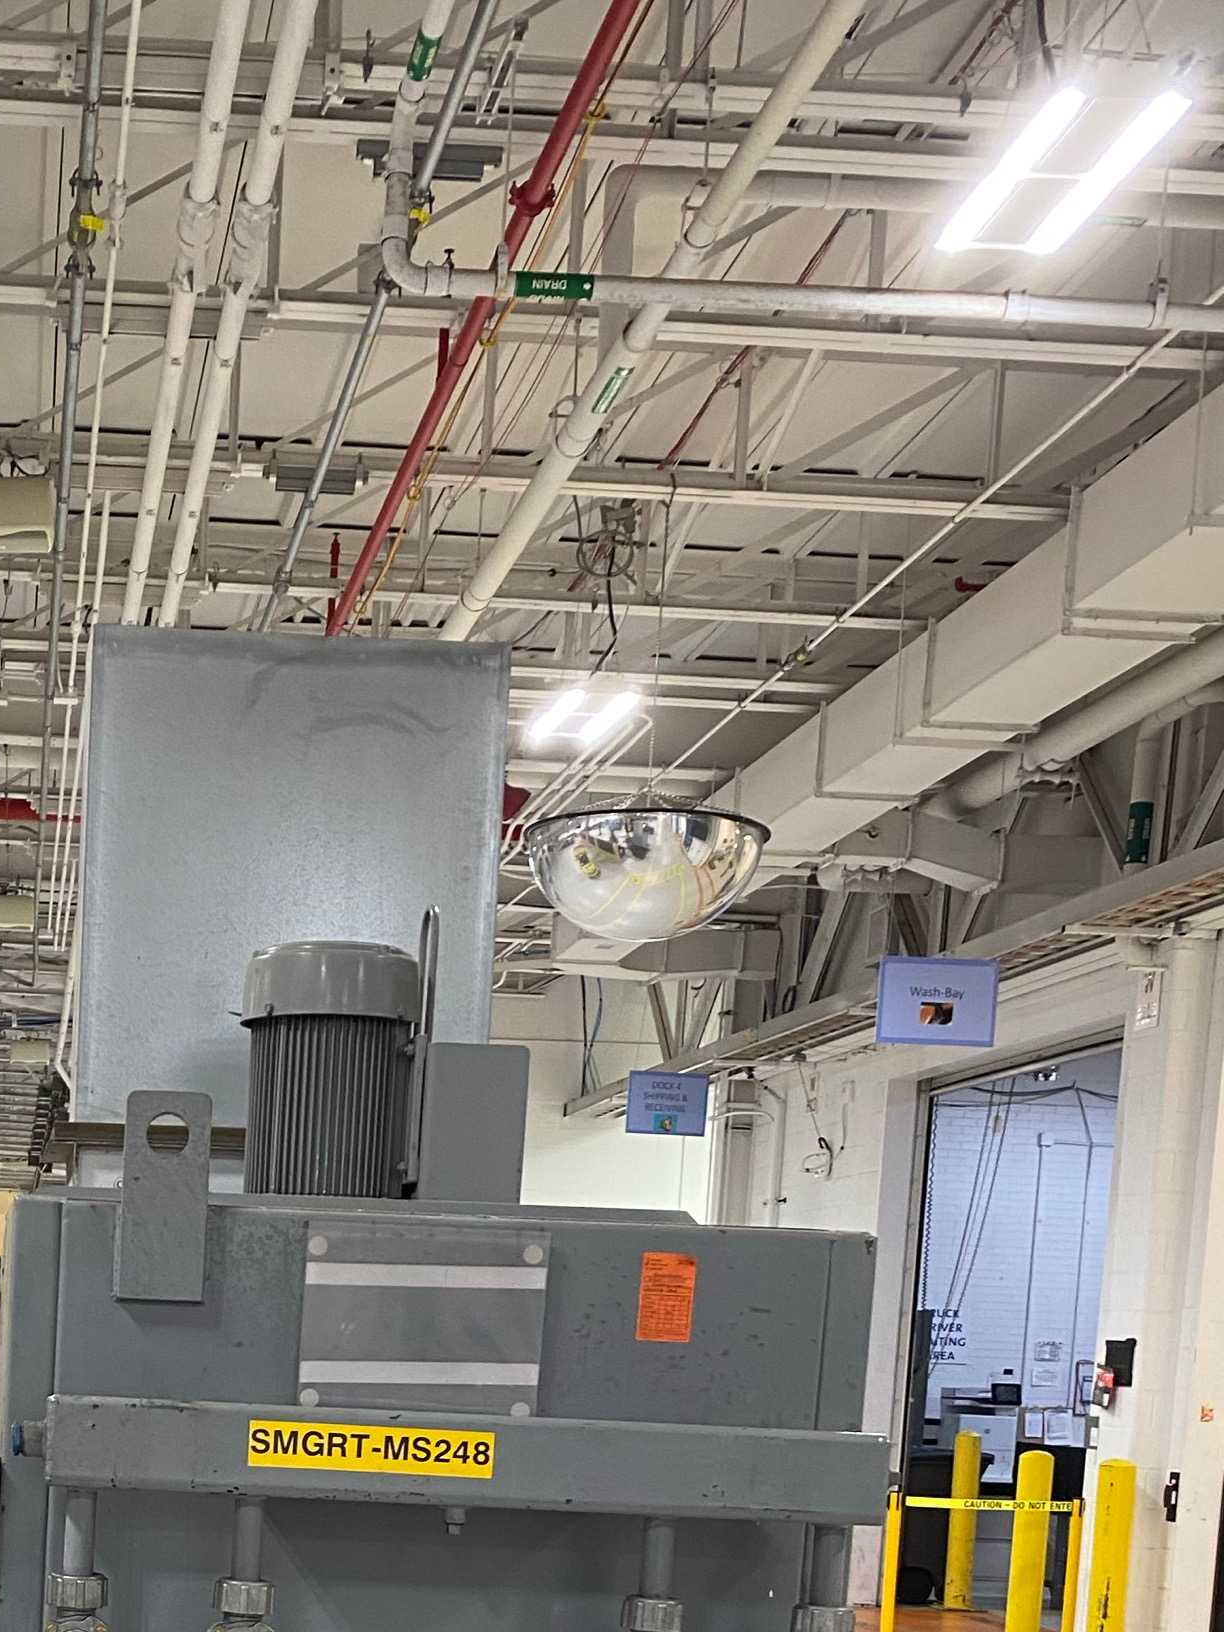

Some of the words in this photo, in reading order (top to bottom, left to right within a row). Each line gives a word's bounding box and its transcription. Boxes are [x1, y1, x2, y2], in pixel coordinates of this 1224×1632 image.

[532, 279, 567, 290] DRAIN
[909, 986, 965, 1000] Wash-Bay
[931, 1309, 960, 1319] RUCK
[930, 1323, 963, 1333] RIVER
[250, 1428, 490, 1466] SMGRT-MS248
[964, 1501, 1002, 1509] CAUTION
[1028, 1502, 1046, 1510] NOT
[1050, 1502, 1072, 1510] ENTE
